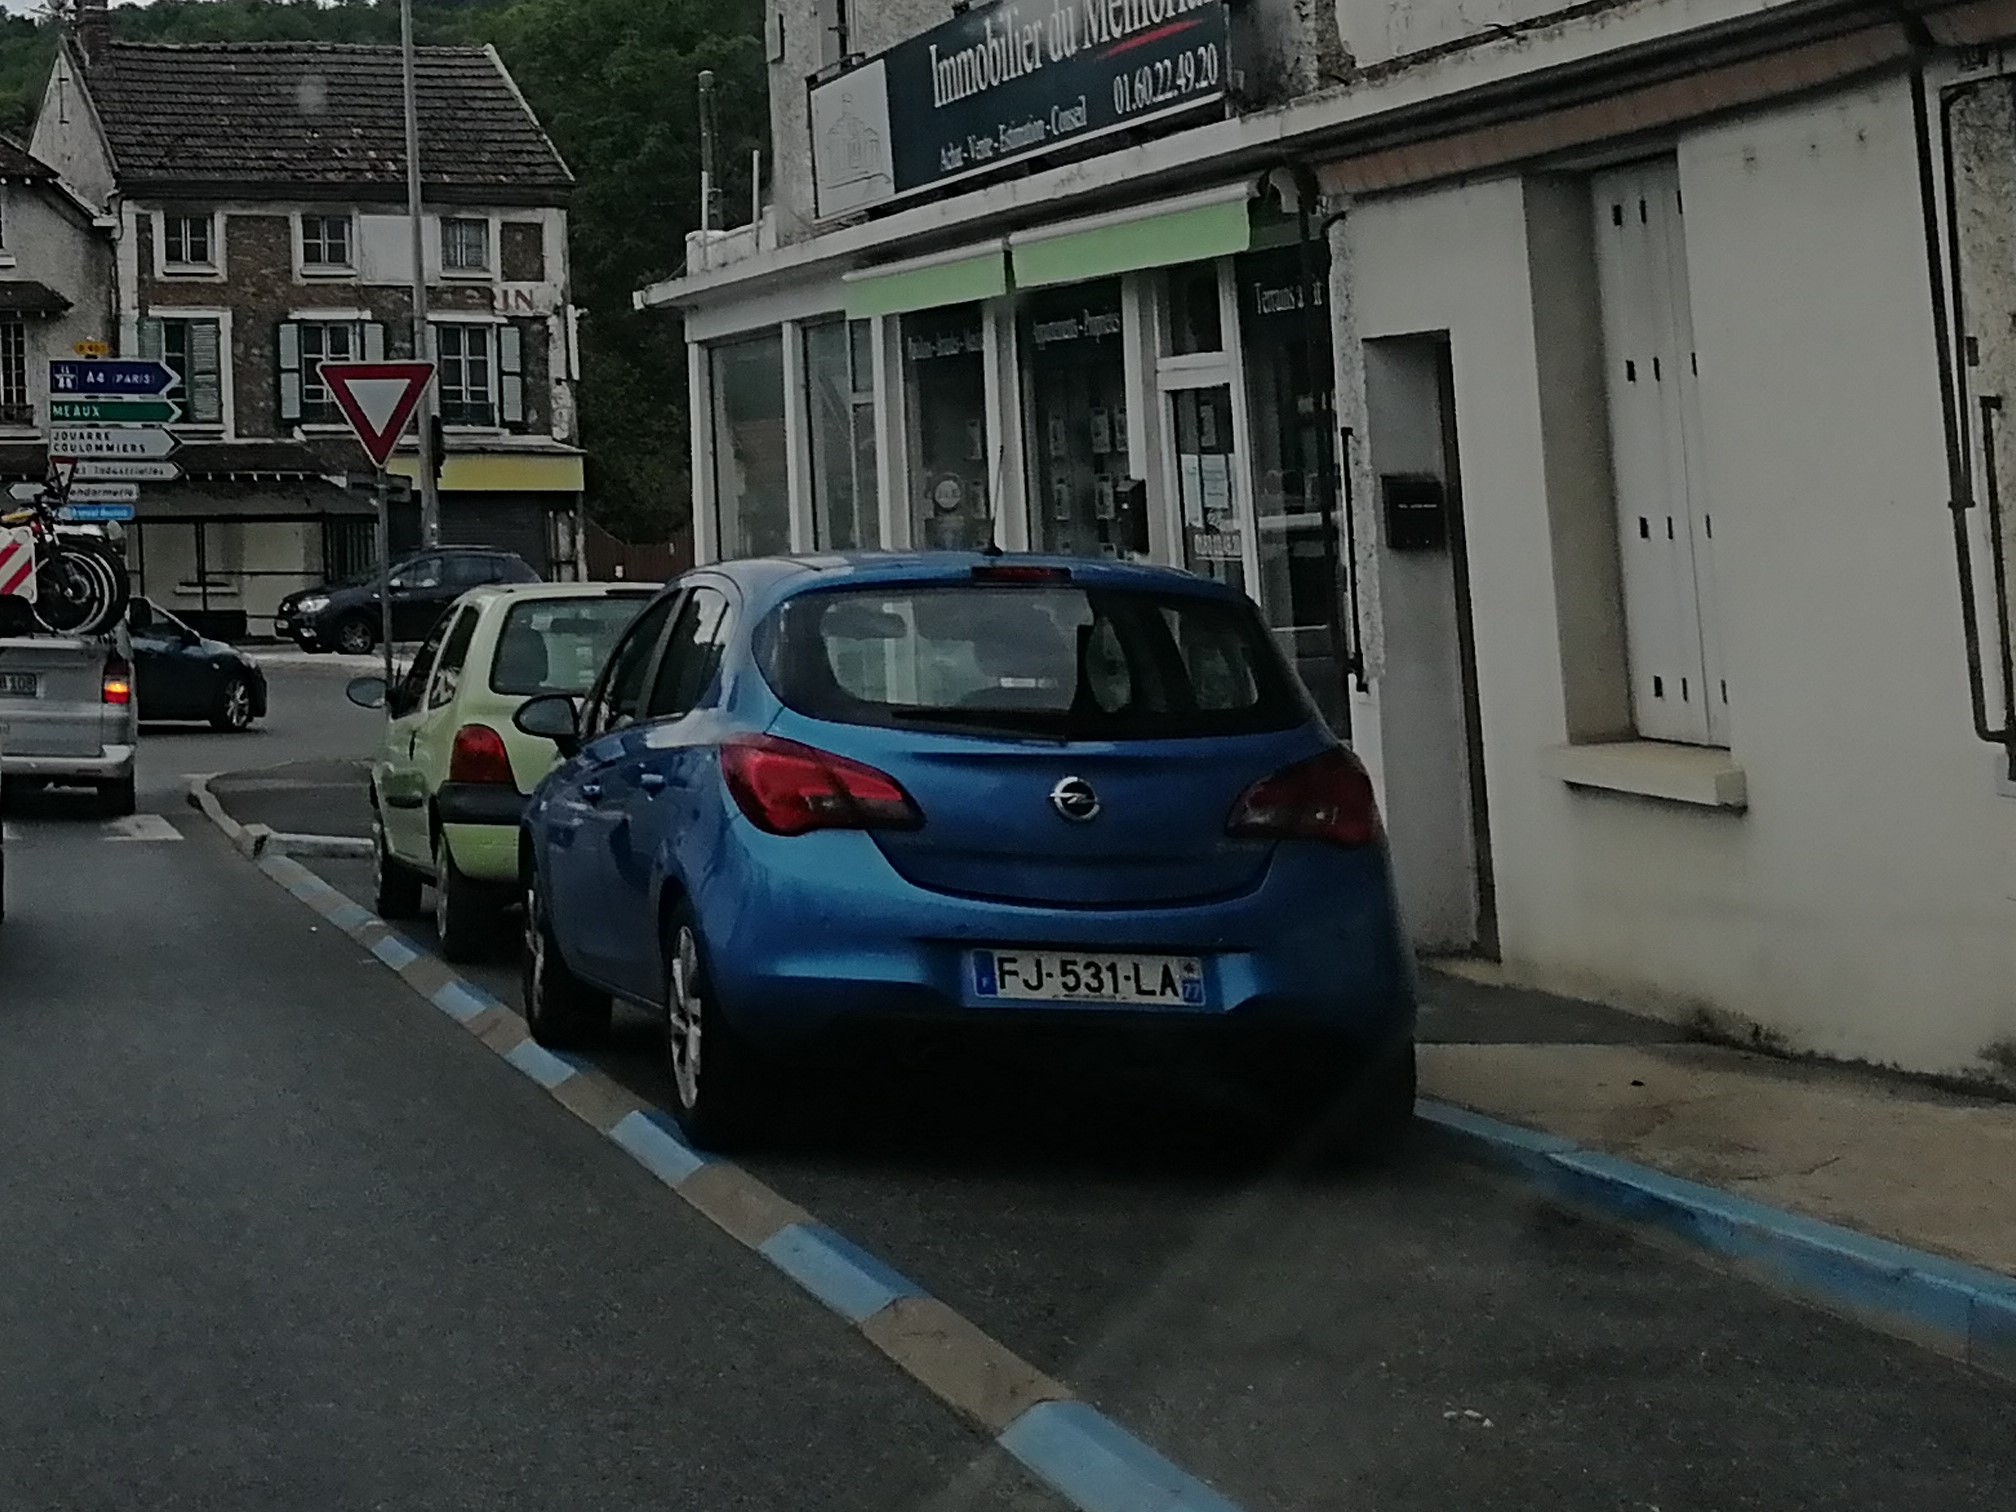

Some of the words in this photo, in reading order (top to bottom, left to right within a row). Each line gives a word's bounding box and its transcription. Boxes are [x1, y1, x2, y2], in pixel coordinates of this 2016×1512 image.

[929, 7, 1042, 108] Immobilier
[1049, 2, 1077, 62] du
[1113, 42, 1218, 114] 01.60.22.49.20
[86, 370, 105, 384] A4
[53, 404, 101, 418] MEAUX
[53, 431, 111, 441] JOUARRE
[53, 443, 146, 454] COULOMMIERS
[69, 487, 134, 497] endarmerie
[997, 957, 1180, 998] FJ-531-LA
